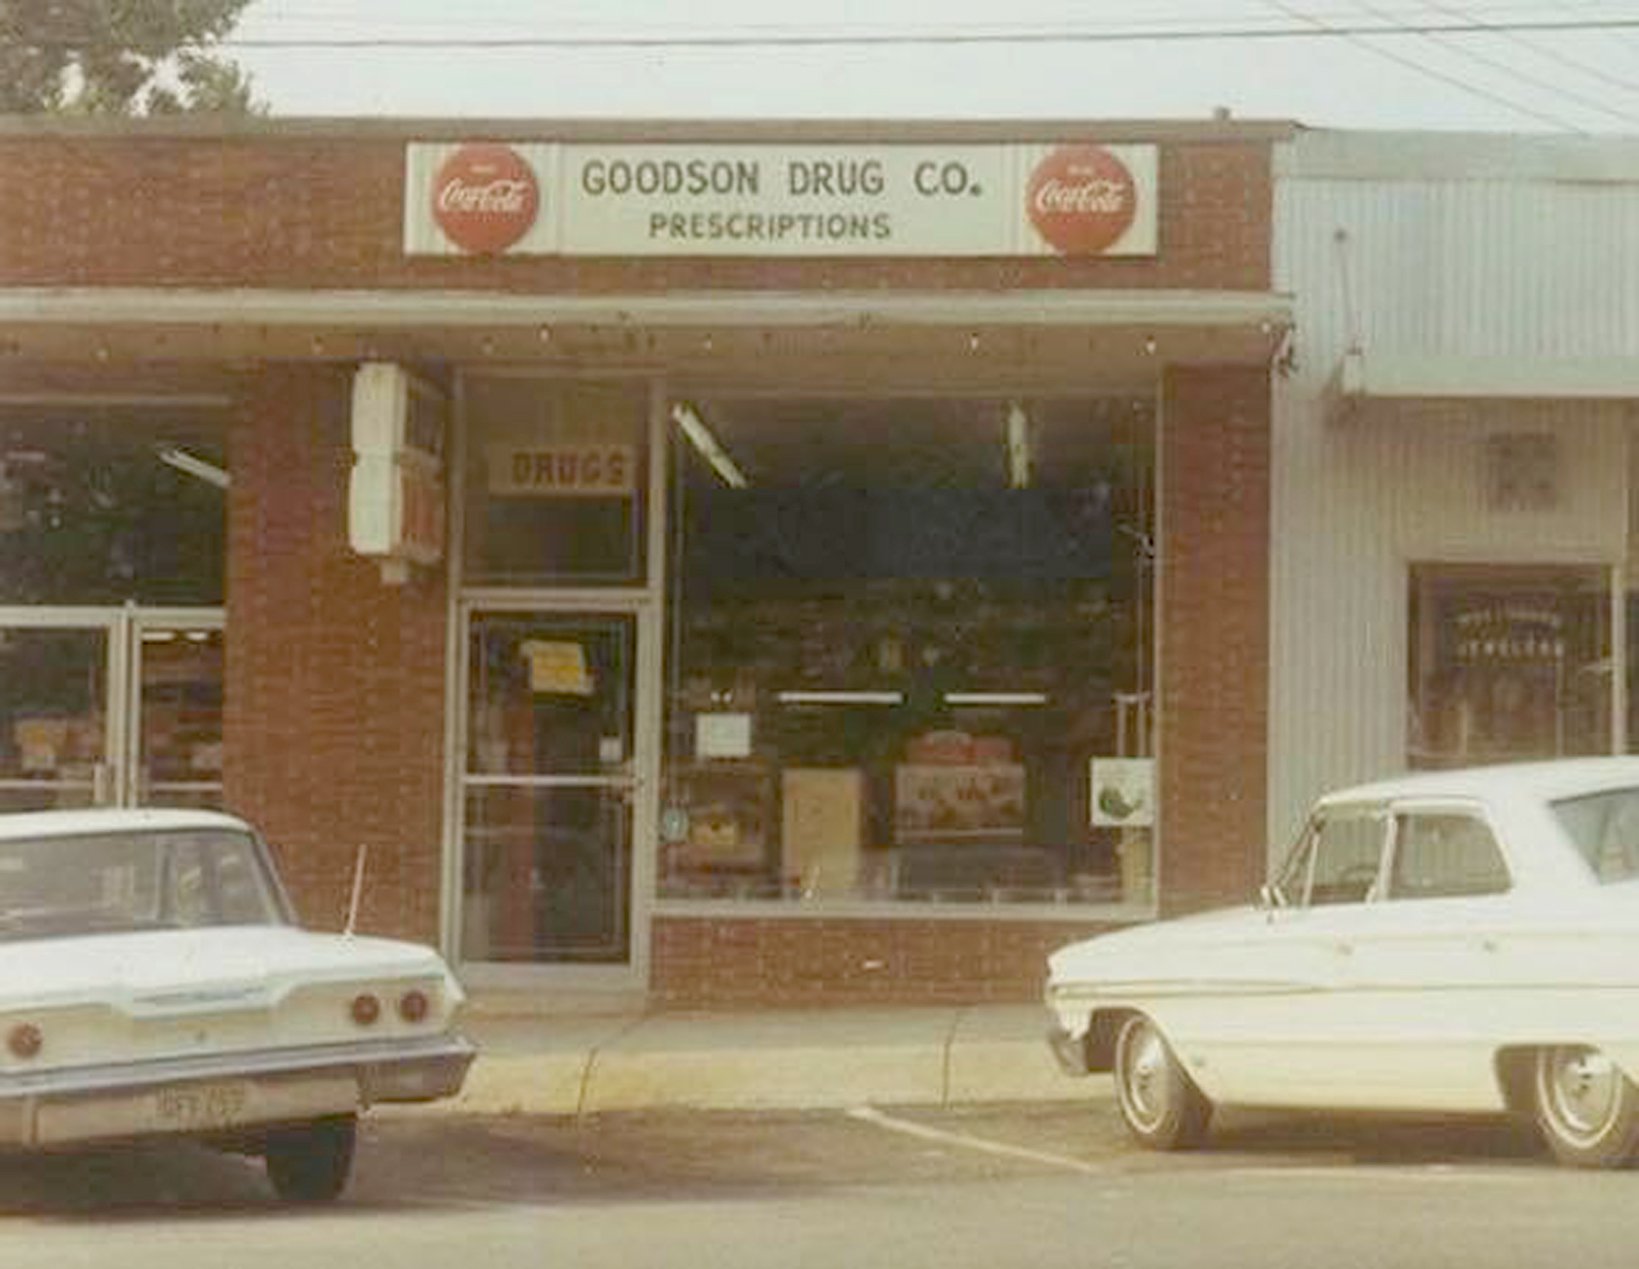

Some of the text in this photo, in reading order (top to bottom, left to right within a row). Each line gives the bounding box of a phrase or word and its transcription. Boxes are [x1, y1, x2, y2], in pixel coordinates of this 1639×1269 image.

[582, 160, 982, 196] GOODSON DRUG CO.
[649, 213, 891, 239] PRESCRIPTIONS
[511, 451, 624, 486] DRUGS
